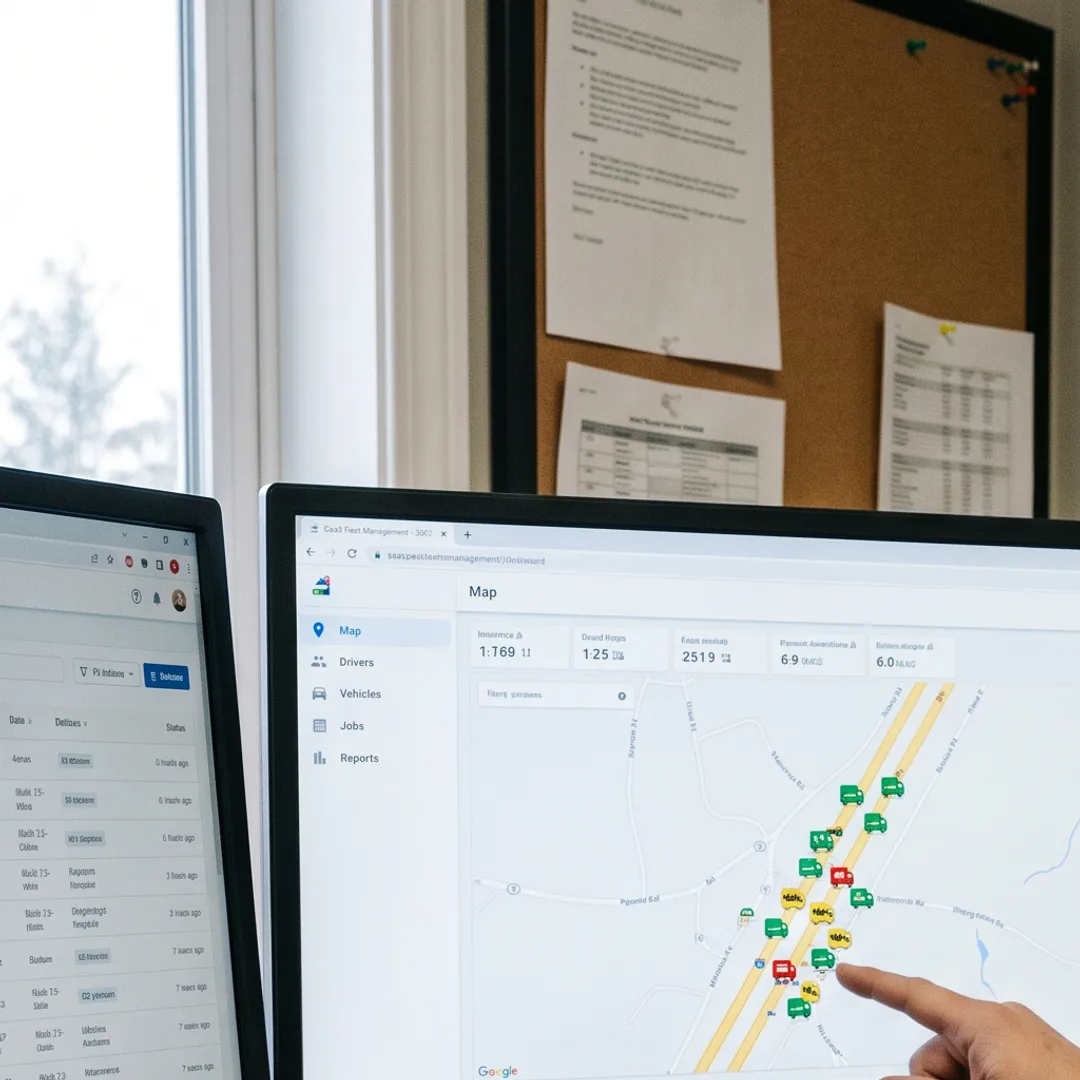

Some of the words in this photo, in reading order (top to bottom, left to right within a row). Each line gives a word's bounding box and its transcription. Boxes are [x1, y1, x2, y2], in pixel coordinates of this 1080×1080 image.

[362, 527, 409, 538] Management
[469, 585, 497, 600] Map
[339, 625, 362, 638] Map
[339, 656, 375, 667] Drivers
[340, 687, 382, 699] Vehicles
[340, 720, 365, 731] Jobs
[340, 752, 380, 764] Reports
[185, 835, 195, 843] ago
[187, 872, 198, 881] ago
[191, 909, 202, 918] ago
[478, 1065, 518, 1079] Google
